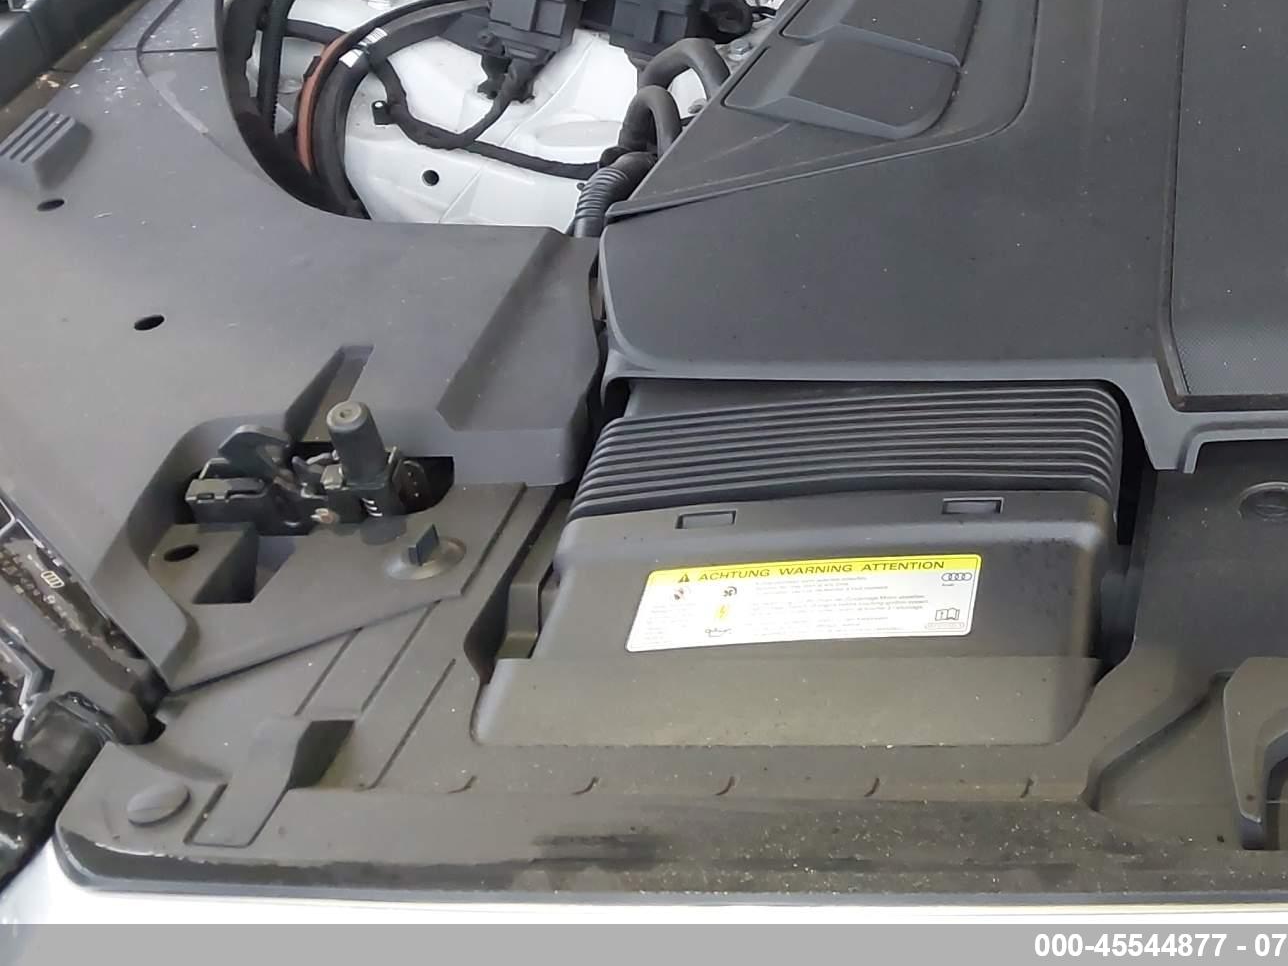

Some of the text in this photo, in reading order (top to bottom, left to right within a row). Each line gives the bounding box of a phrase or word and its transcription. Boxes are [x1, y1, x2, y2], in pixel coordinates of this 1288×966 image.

[698, 560, 945, 582] ACHTUNG WARNING ATTENTION
